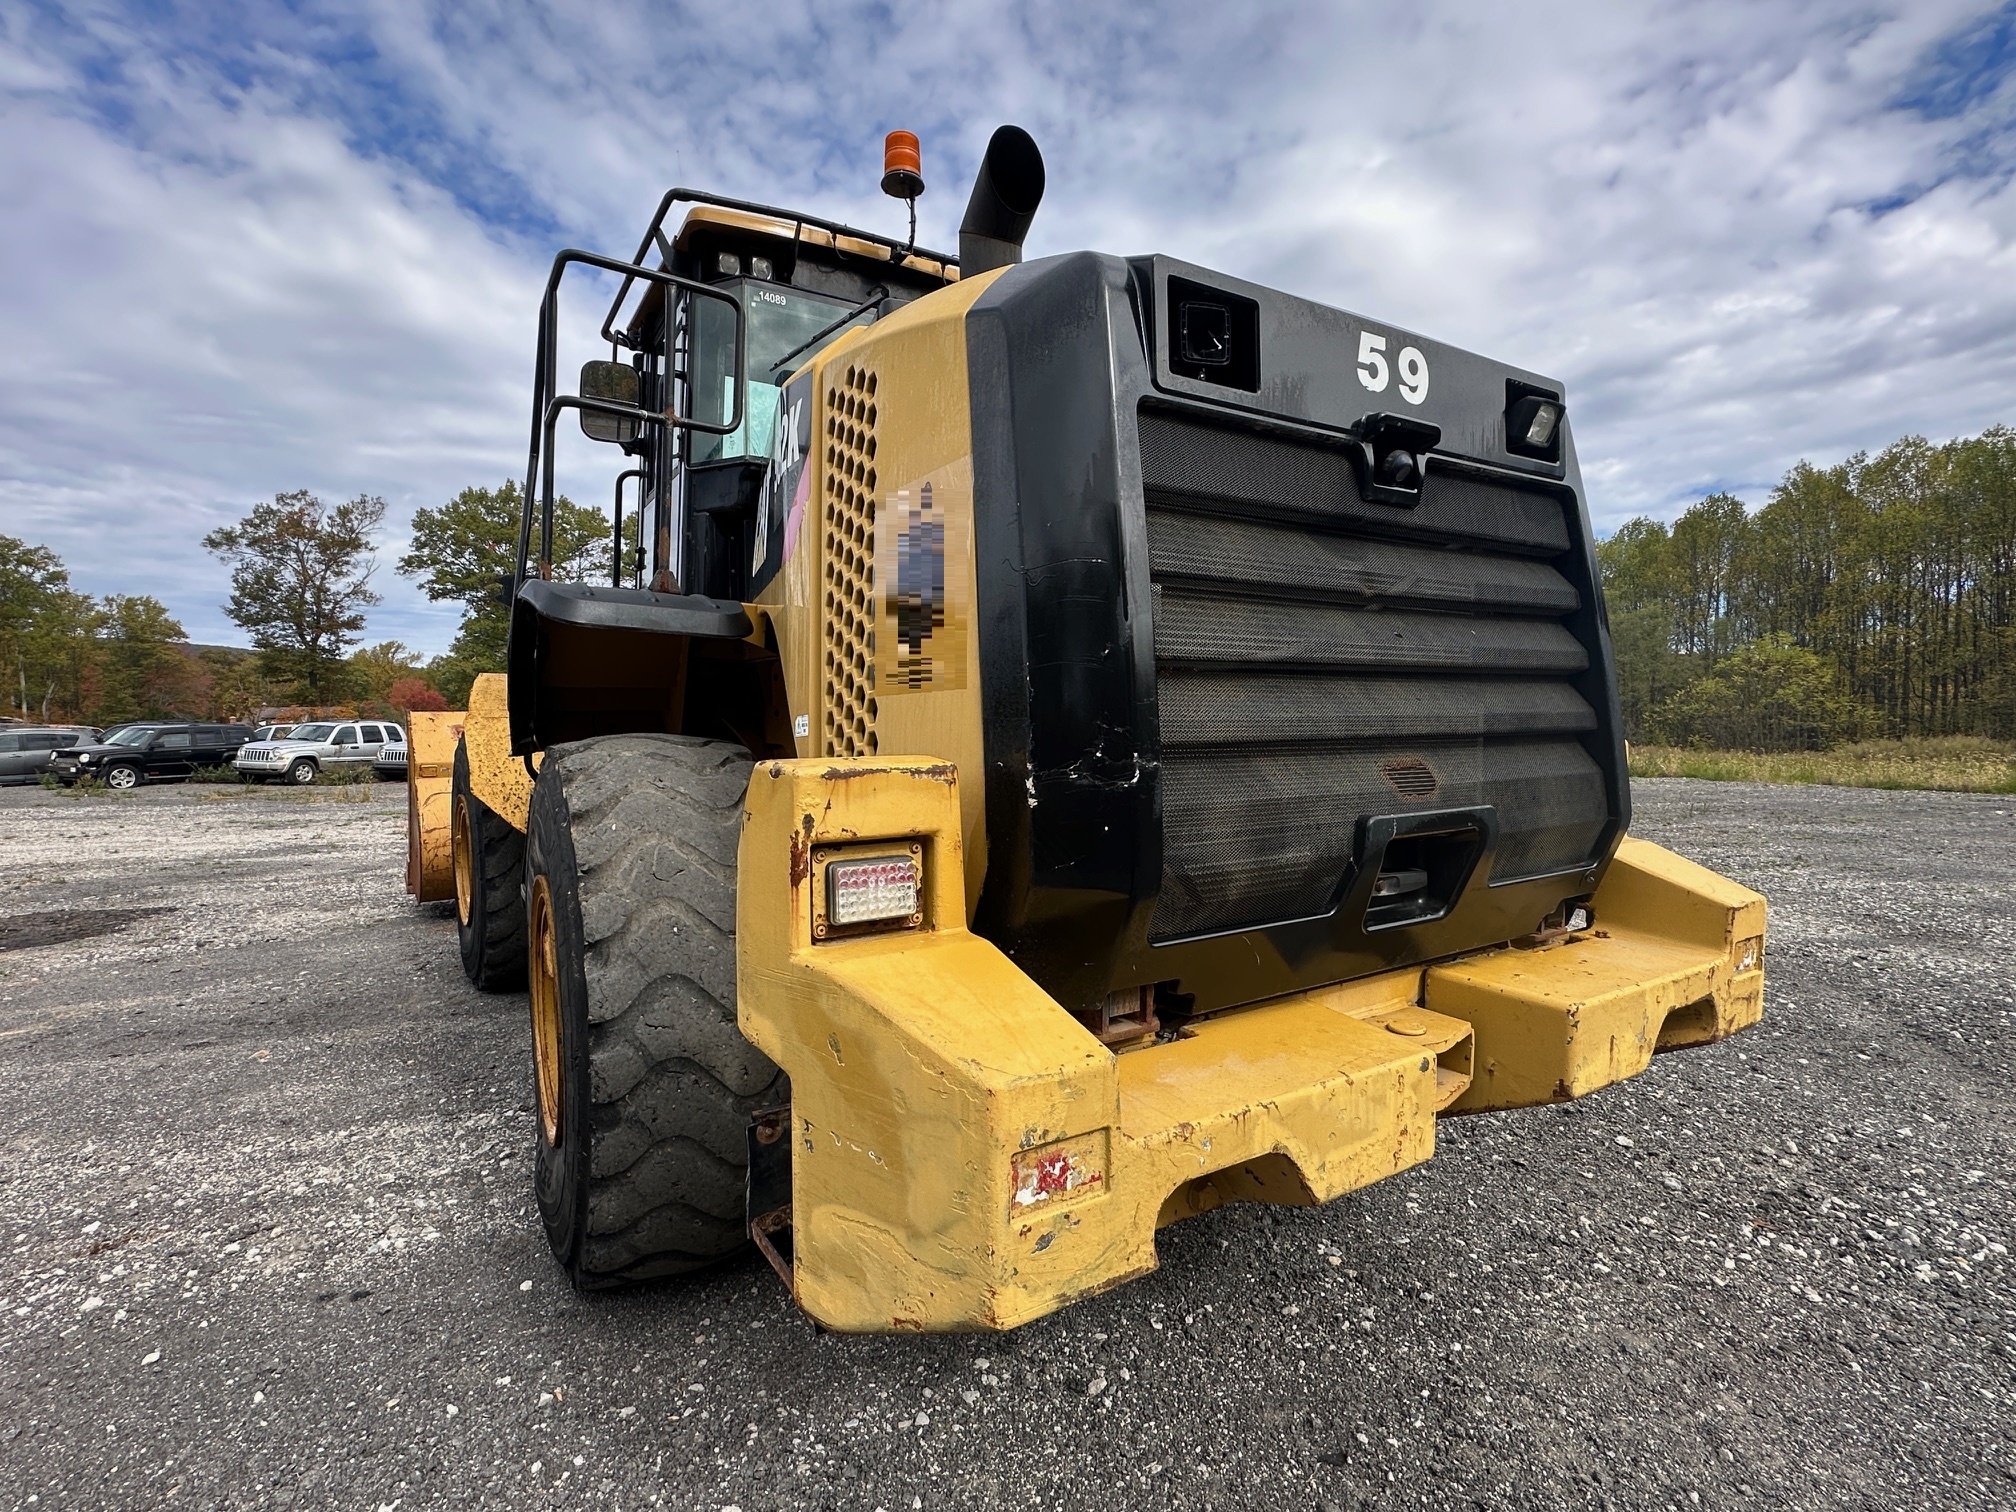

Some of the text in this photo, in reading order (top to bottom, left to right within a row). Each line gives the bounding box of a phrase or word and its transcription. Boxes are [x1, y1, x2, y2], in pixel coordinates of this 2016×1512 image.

[759, 291, 787, 306] 14089
[1357, 331, 1429, 405] 59
[777, 398, 803, 484] 2K
